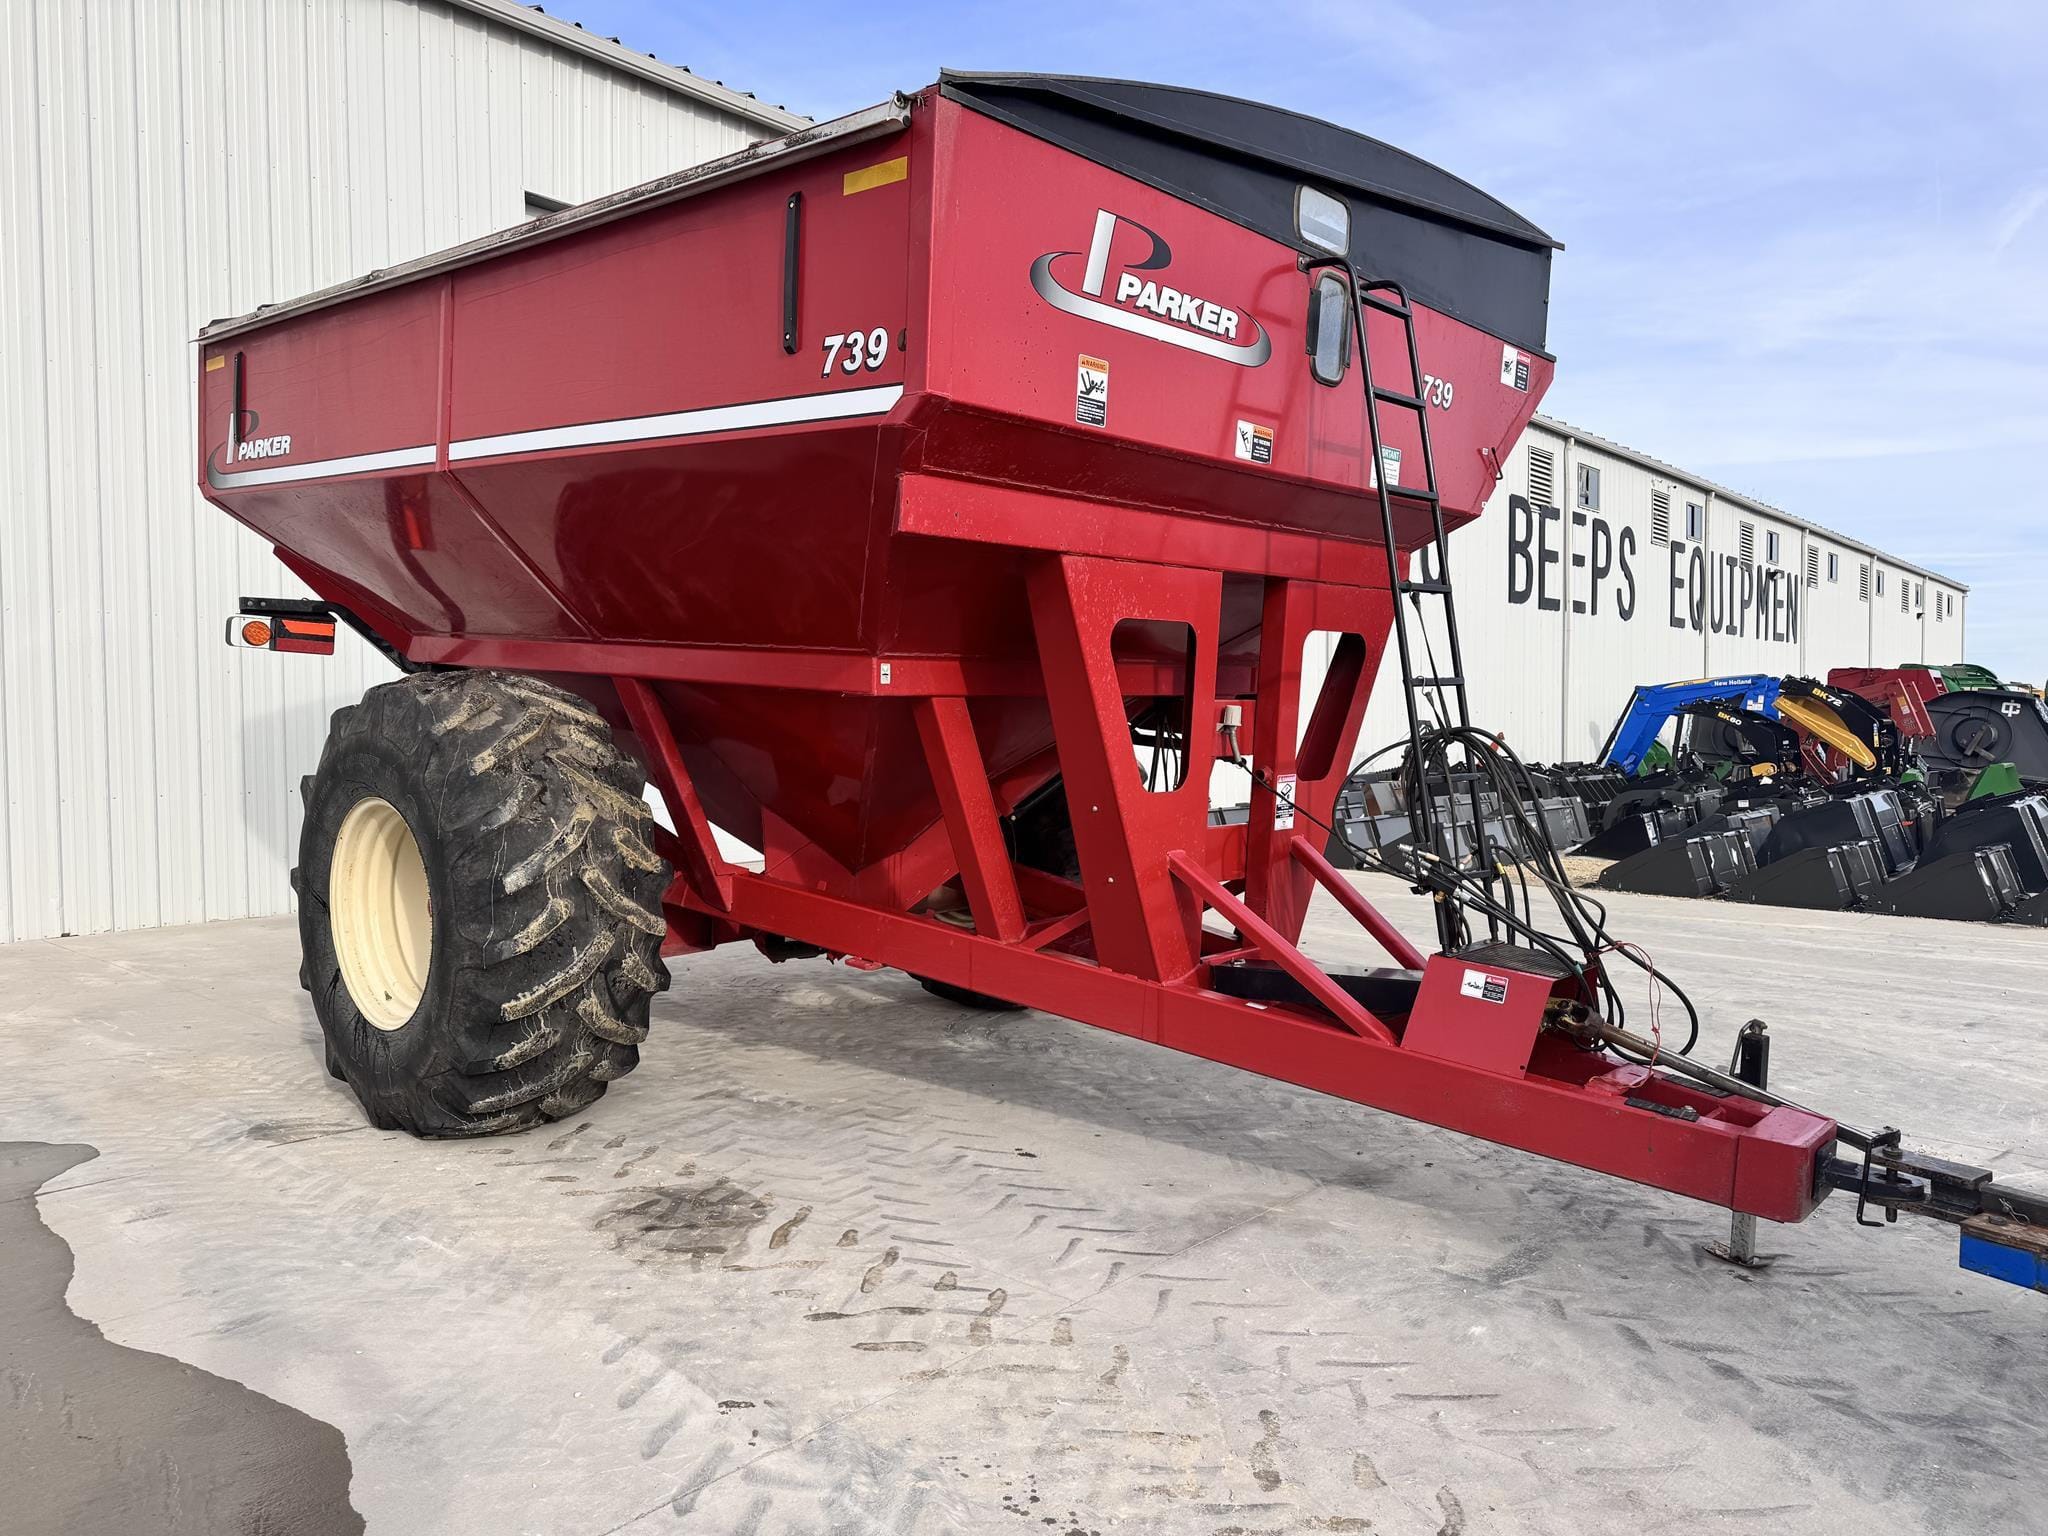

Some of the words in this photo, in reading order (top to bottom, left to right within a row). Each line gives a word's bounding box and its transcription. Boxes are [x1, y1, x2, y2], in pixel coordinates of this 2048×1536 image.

[1115, 271, 1239, 341] PARKER
[821, 326, 889, 379] 739
[1423, 373, 1454, 411] 739
[237, 434, 292, 461] PARKER
[1508, 493, 1637, 622] BEEPS
[1670, 540, 1803, 645] EQUIPMEN
[1728, 678, 1752, 686] Holland
[1812, 687, 1843, 707] BK72
[1717, 711, 1742, 726] BK60
